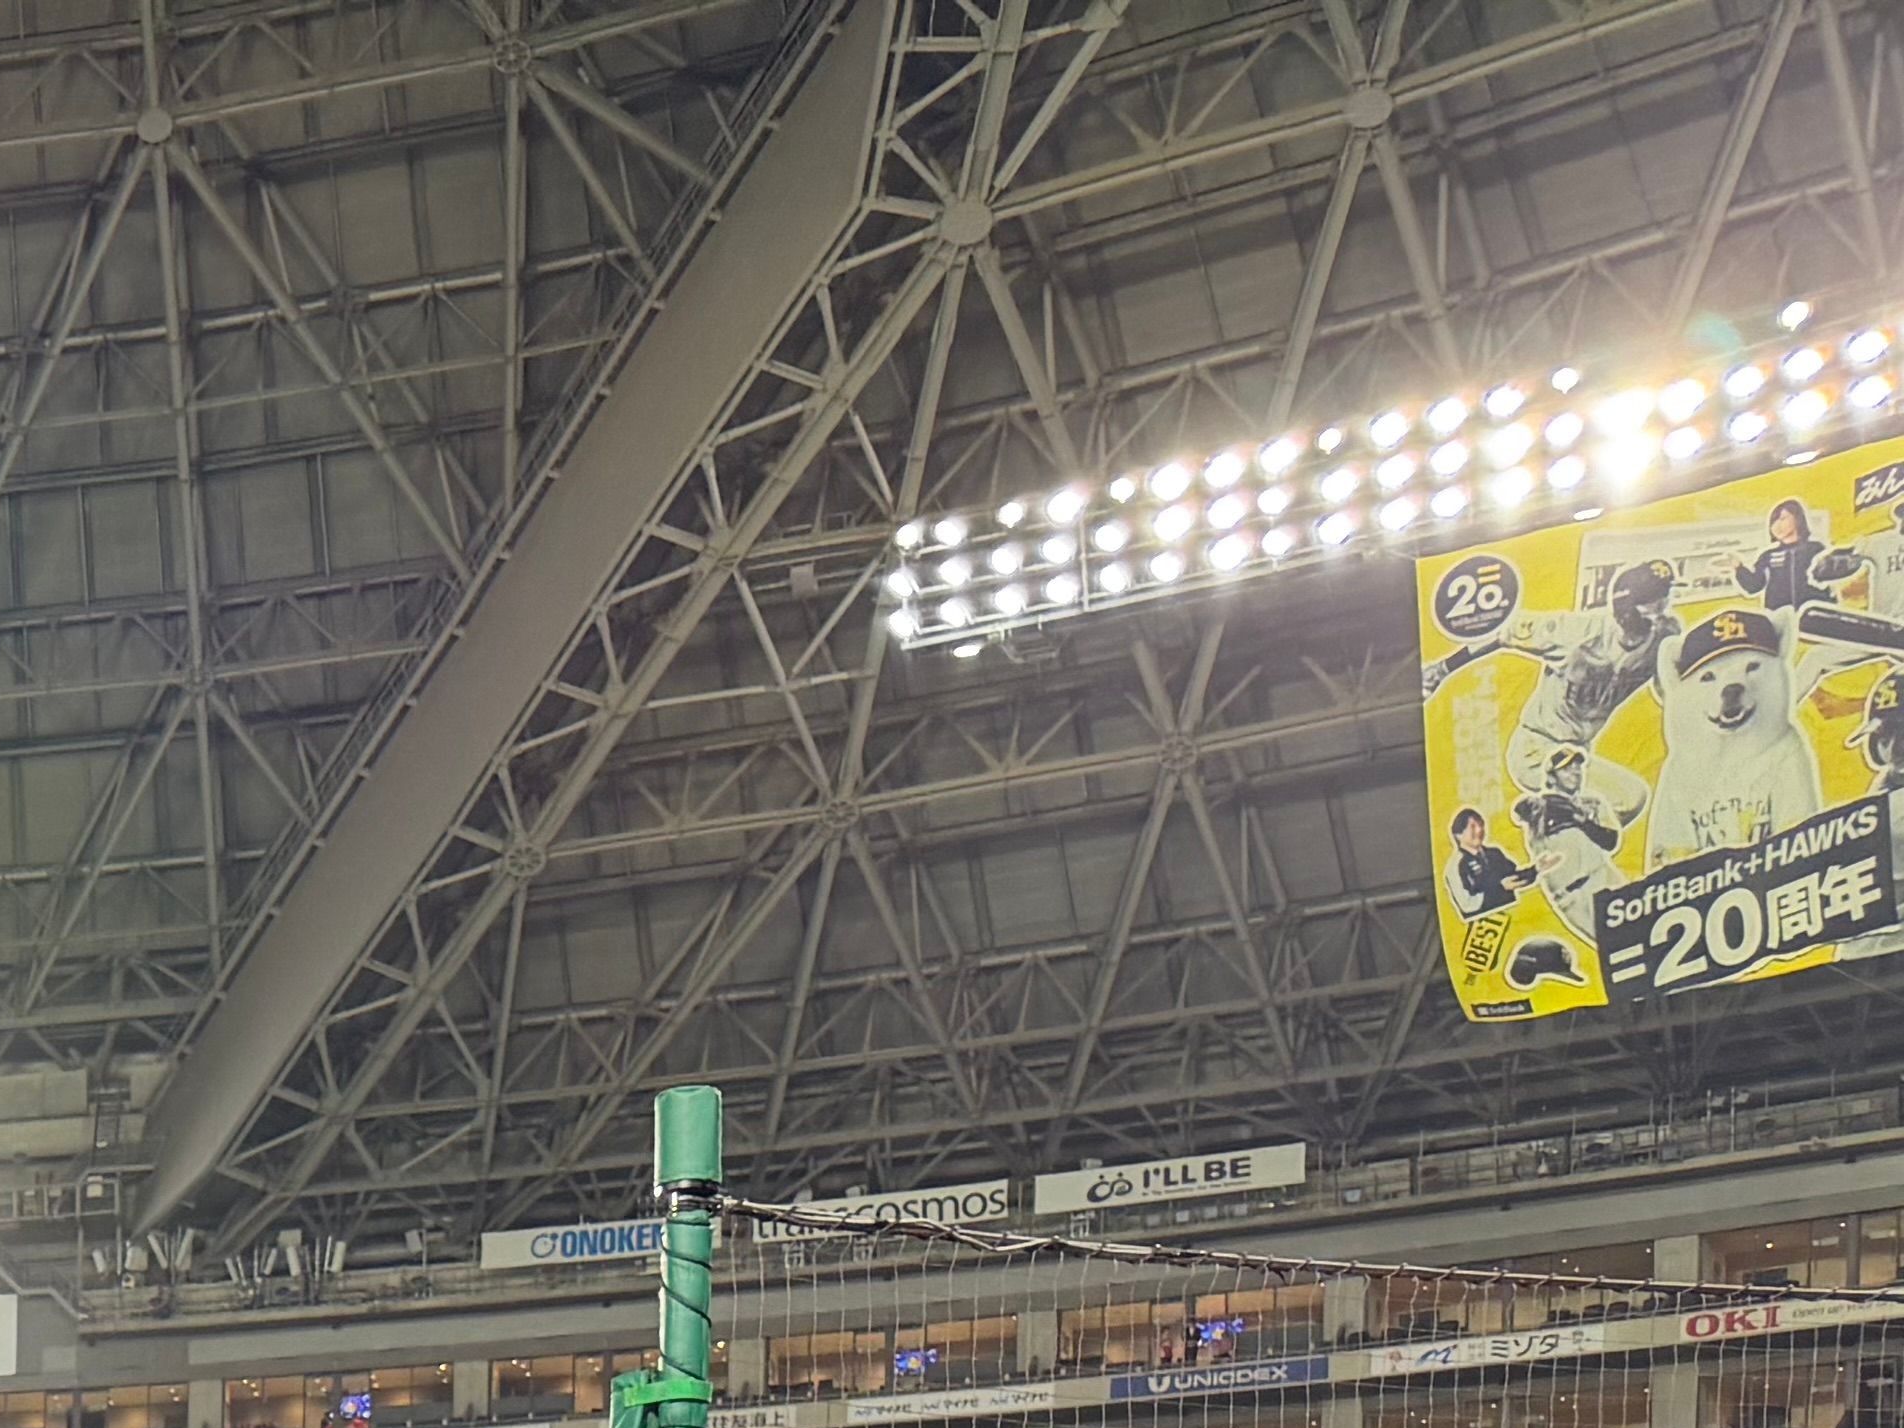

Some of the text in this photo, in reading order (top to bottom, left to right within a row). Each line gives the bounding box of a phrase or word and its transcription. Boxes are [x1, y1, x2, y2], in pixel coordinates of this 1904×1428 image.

[1143, 1157, 1252, 1190] I'LL BE
[1685, 1306, 1782, 1339] OKI
